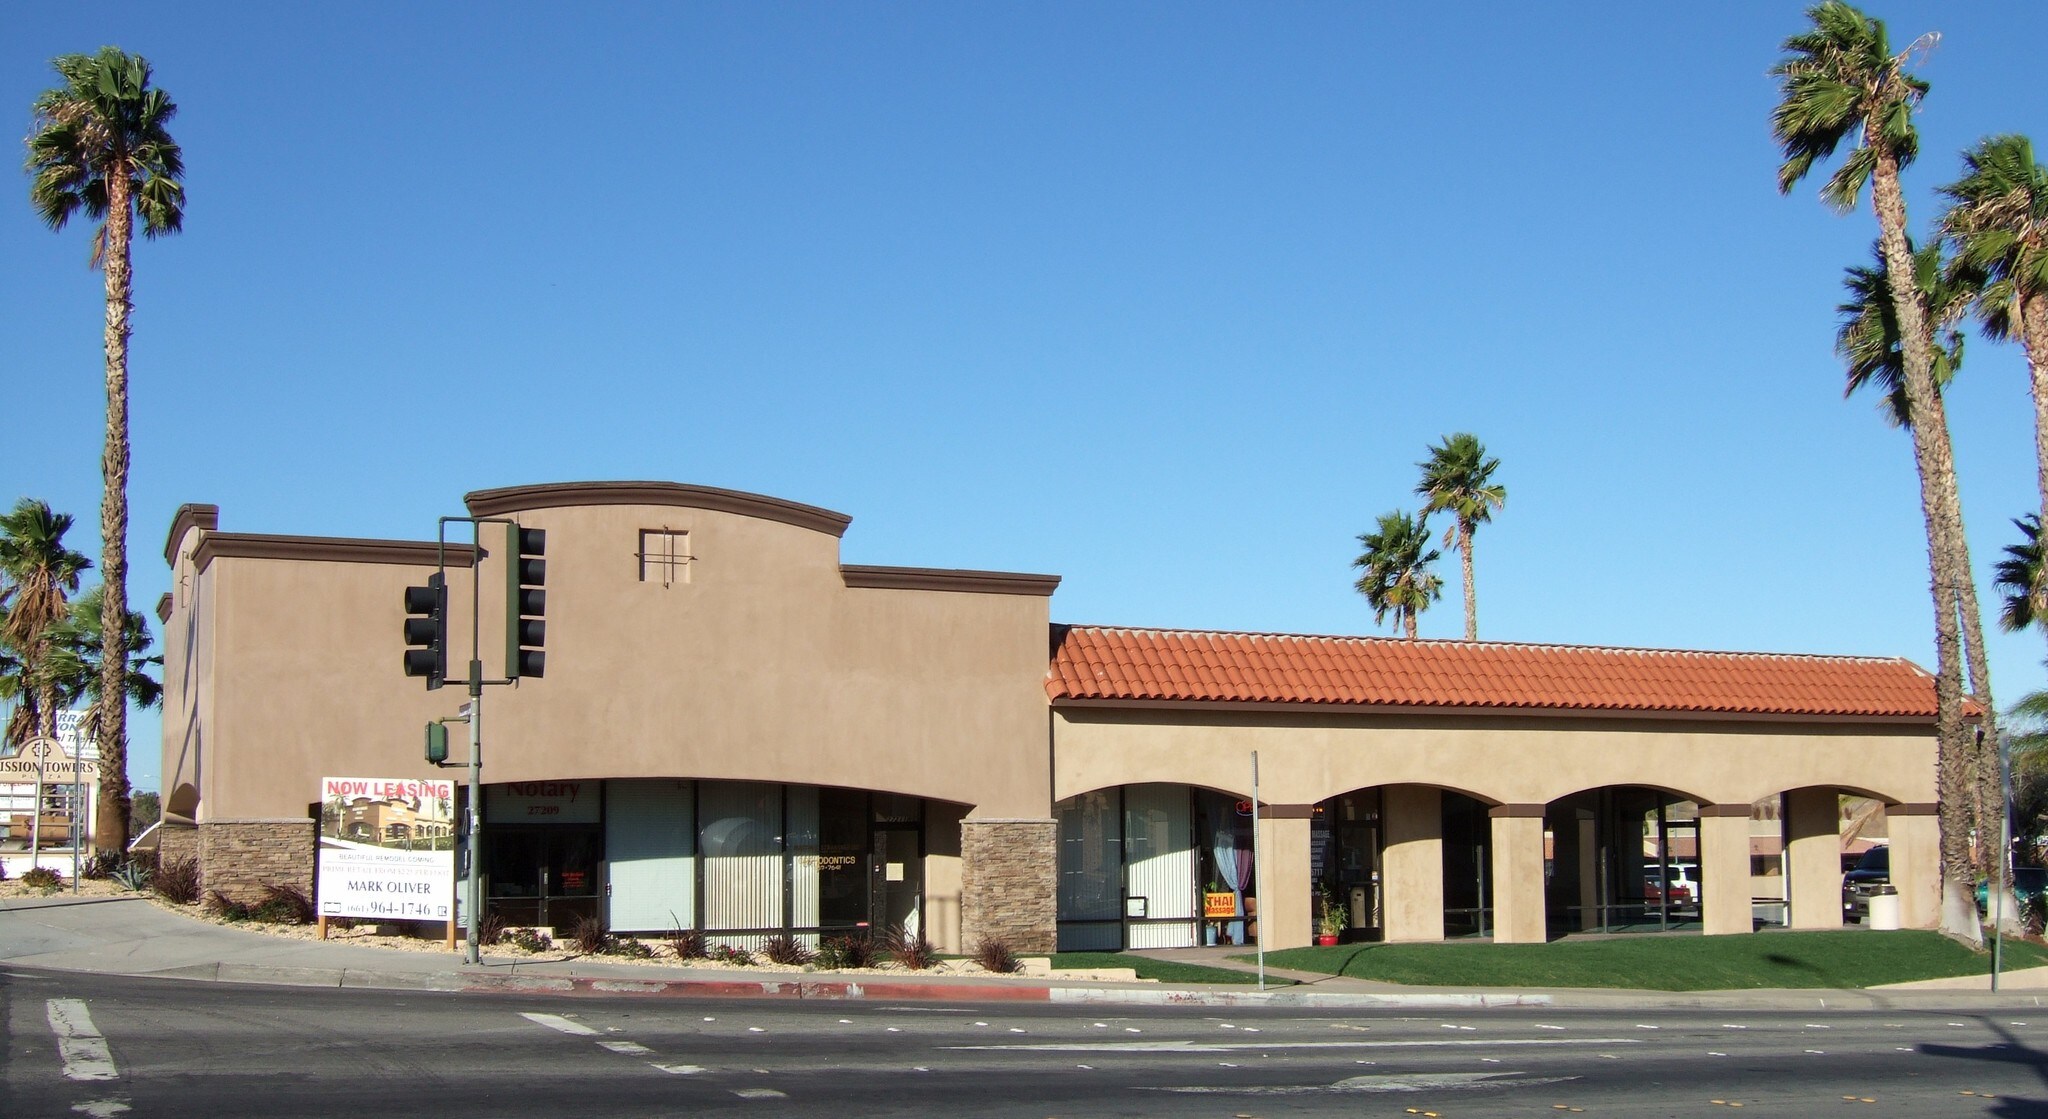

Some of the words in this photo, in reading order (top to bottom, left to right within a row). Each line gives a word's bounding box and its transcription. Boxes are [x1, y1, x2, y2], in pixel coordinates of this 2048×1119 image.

[0, 761, 39, 772] ISSION
[327, 781, 367, 796] NOW
[374, 782, 449, 798] LEASING
[507, 781, 580, 803] Notary
[528, 806, 560, 816] 27209
[339, 854, 373, 862] BEAUTIFUL
[376, 855, 405, 863] REMODEL
[408, 856, 434, 864] COMING
[347, 881, 383, 893] MARK
[387, 882, 431, 895] OLIVER
[1207, 896, 1233, 907] THAI
[370, 901, 431, 916] 964-1746
[1206, 906, 1235, 915] Massage
